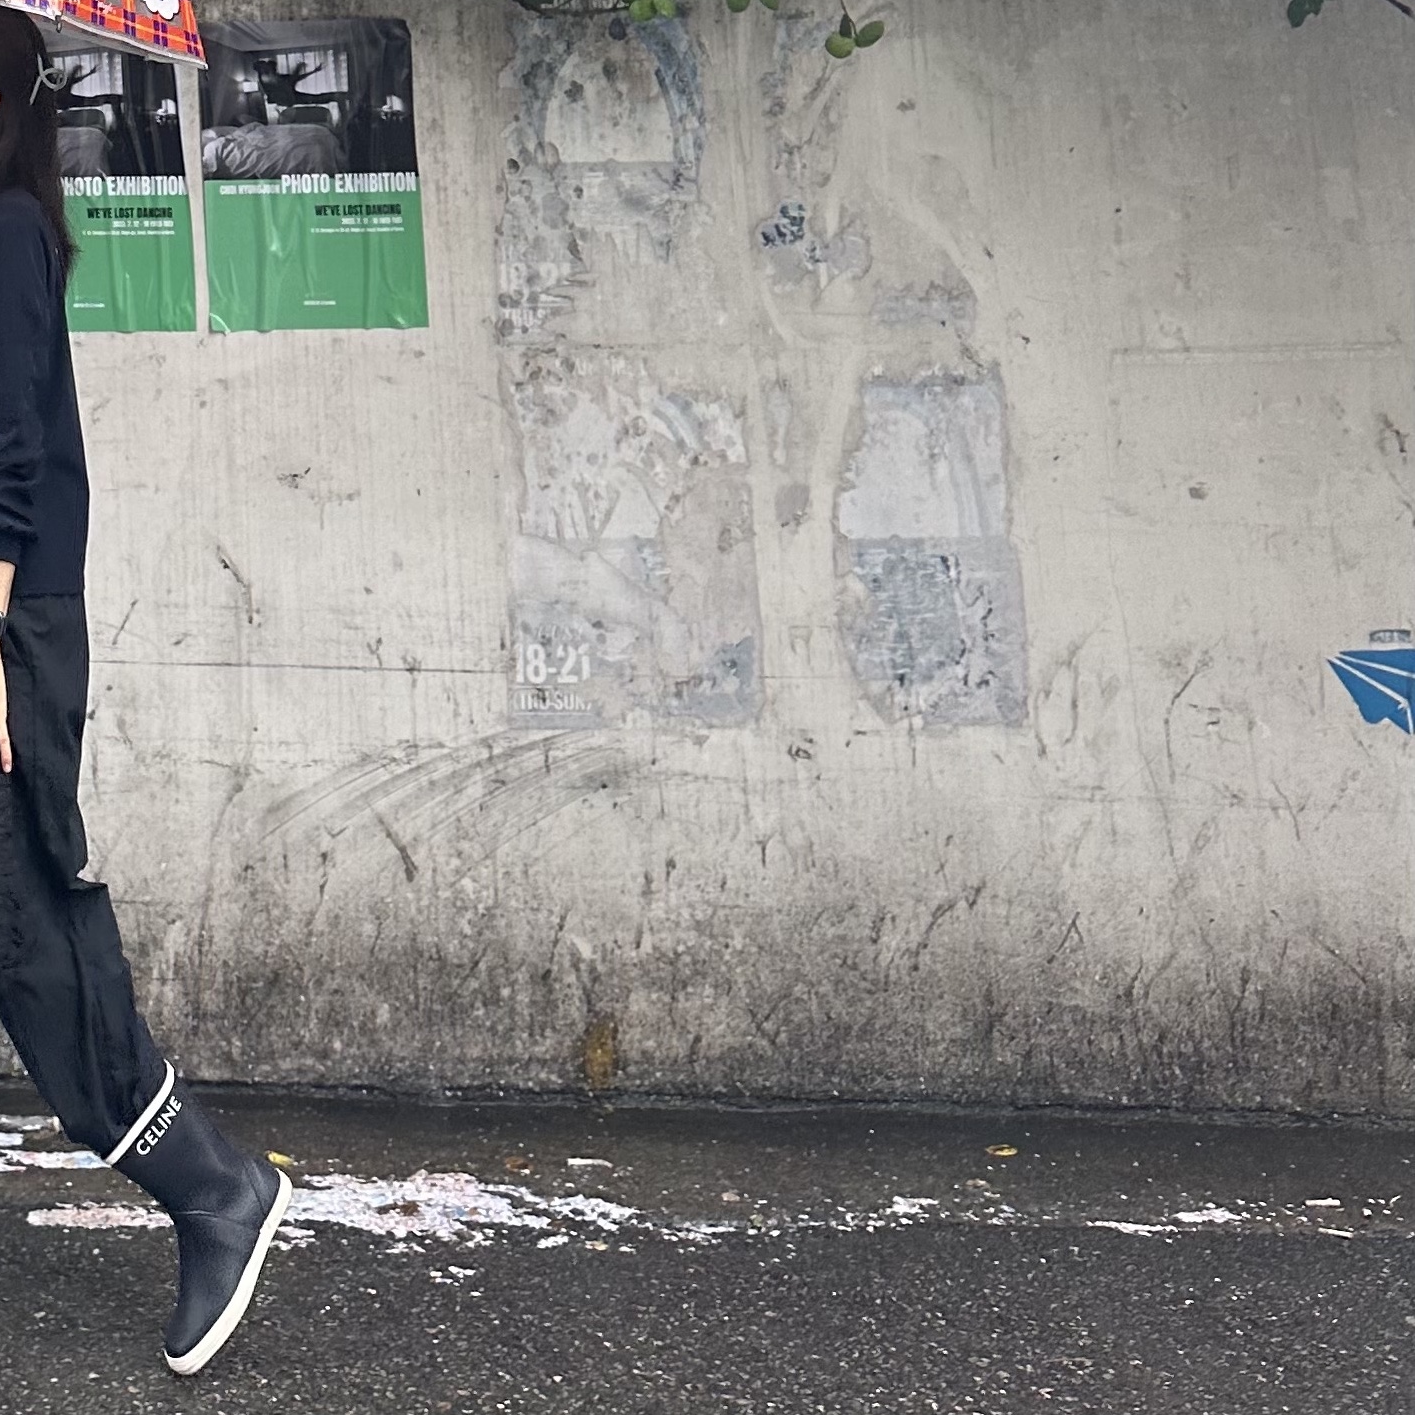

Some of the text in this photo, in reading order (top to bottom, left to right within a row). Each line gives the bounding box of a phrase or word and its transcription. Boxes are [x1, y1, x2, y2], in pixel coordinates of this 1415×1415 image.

[61, 176, 188, 196] HOTO EXHIBITION
[281, 173, 330, 194] PHOTO
[334, 172, 417, 193] EXHIBITION
[87, 206, 173, 219] WE'VE LOST DANCING
[314, 204, 402, 216] WE'VE LOST DANCING
[514, 643, 591, 684] 18-21
[136, 1095, 182, 1156] CELINE
